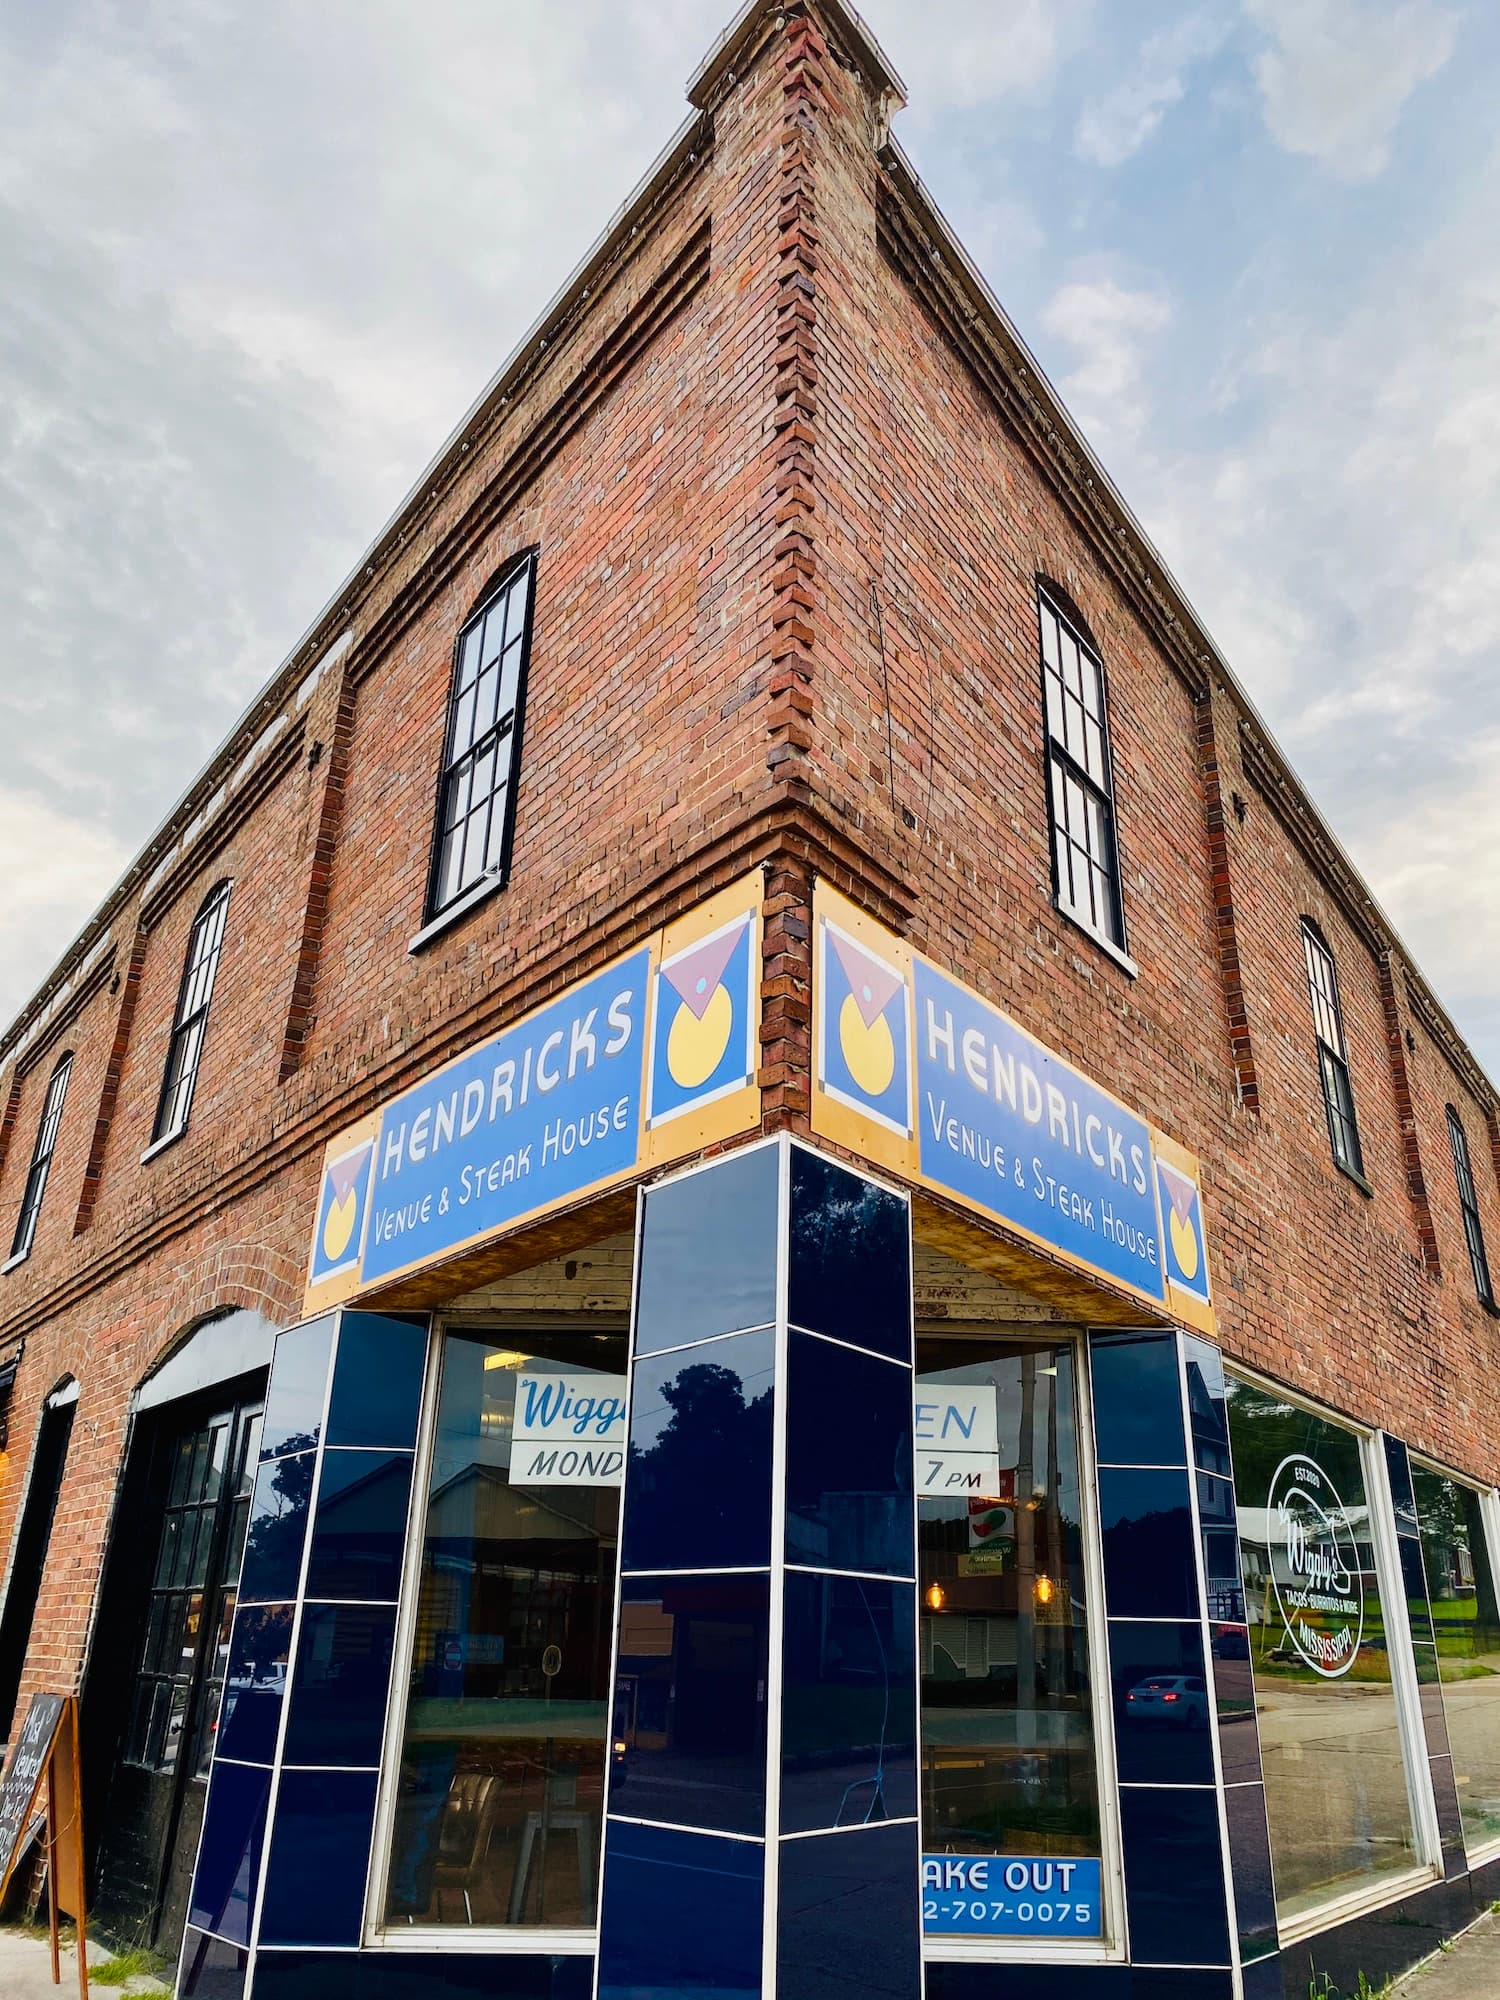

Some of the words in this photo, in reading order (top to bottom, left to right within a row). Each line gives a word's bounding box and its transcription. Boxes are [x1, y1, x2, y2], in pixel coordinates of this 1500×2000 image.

[379, 989, 634, 1180] HENDRICKS
[924, 997, 1149, 1197] HENDRICKS
[374, 1191, 431, 1245] VENUE
[438, 1187, 450, 1216] &
[458, 1143, 531, 1205] STEAK
[541, 1095, 630, 1167] HOUSE
[927, 1090, 1007, 1179] VENUE
[1013, 1156, 1026, 1189] &
[1032, 1156, 1096, 1232] STEAK
[1100, 1194, 1157, 1267] HOUSE
[924, 1460, 944, 1486] 7
[945, 1472, 982, 1488] PM
[1300, 1617, 1352, 1661] MISSISSIPPI
[924, 1901, 1091, 1923] 2-707-0075
[1005, 1862, 1077, 1892] OUT
